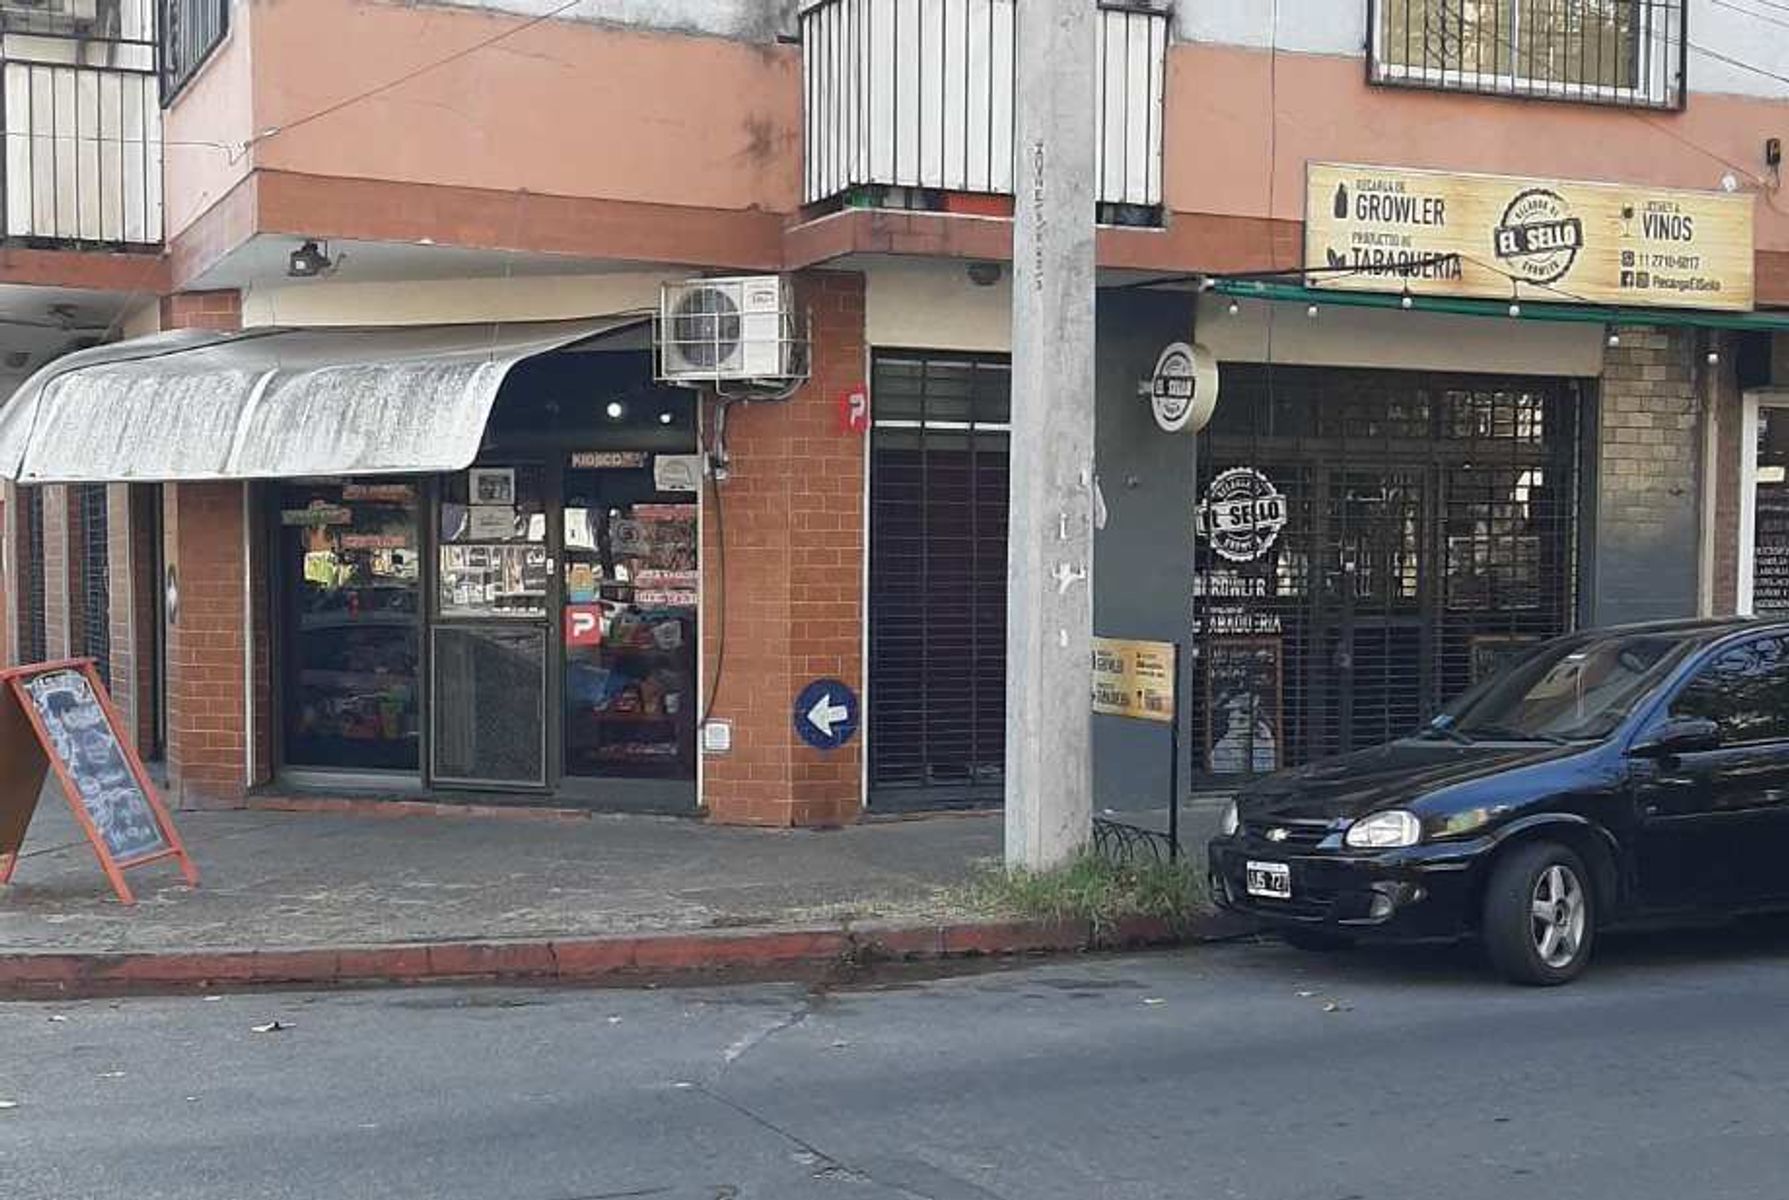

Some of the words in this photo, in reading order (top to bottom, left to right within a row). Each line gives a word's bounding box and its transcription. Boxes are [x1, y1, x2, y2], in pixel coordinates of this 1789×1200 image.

[1356, 194, 1445, 226] GROWLER
[1499, 230, 1519, 253] EL
[1525, 224, 1577, 250] SELLO
[1643, 213, 1692, 241] VINOS
